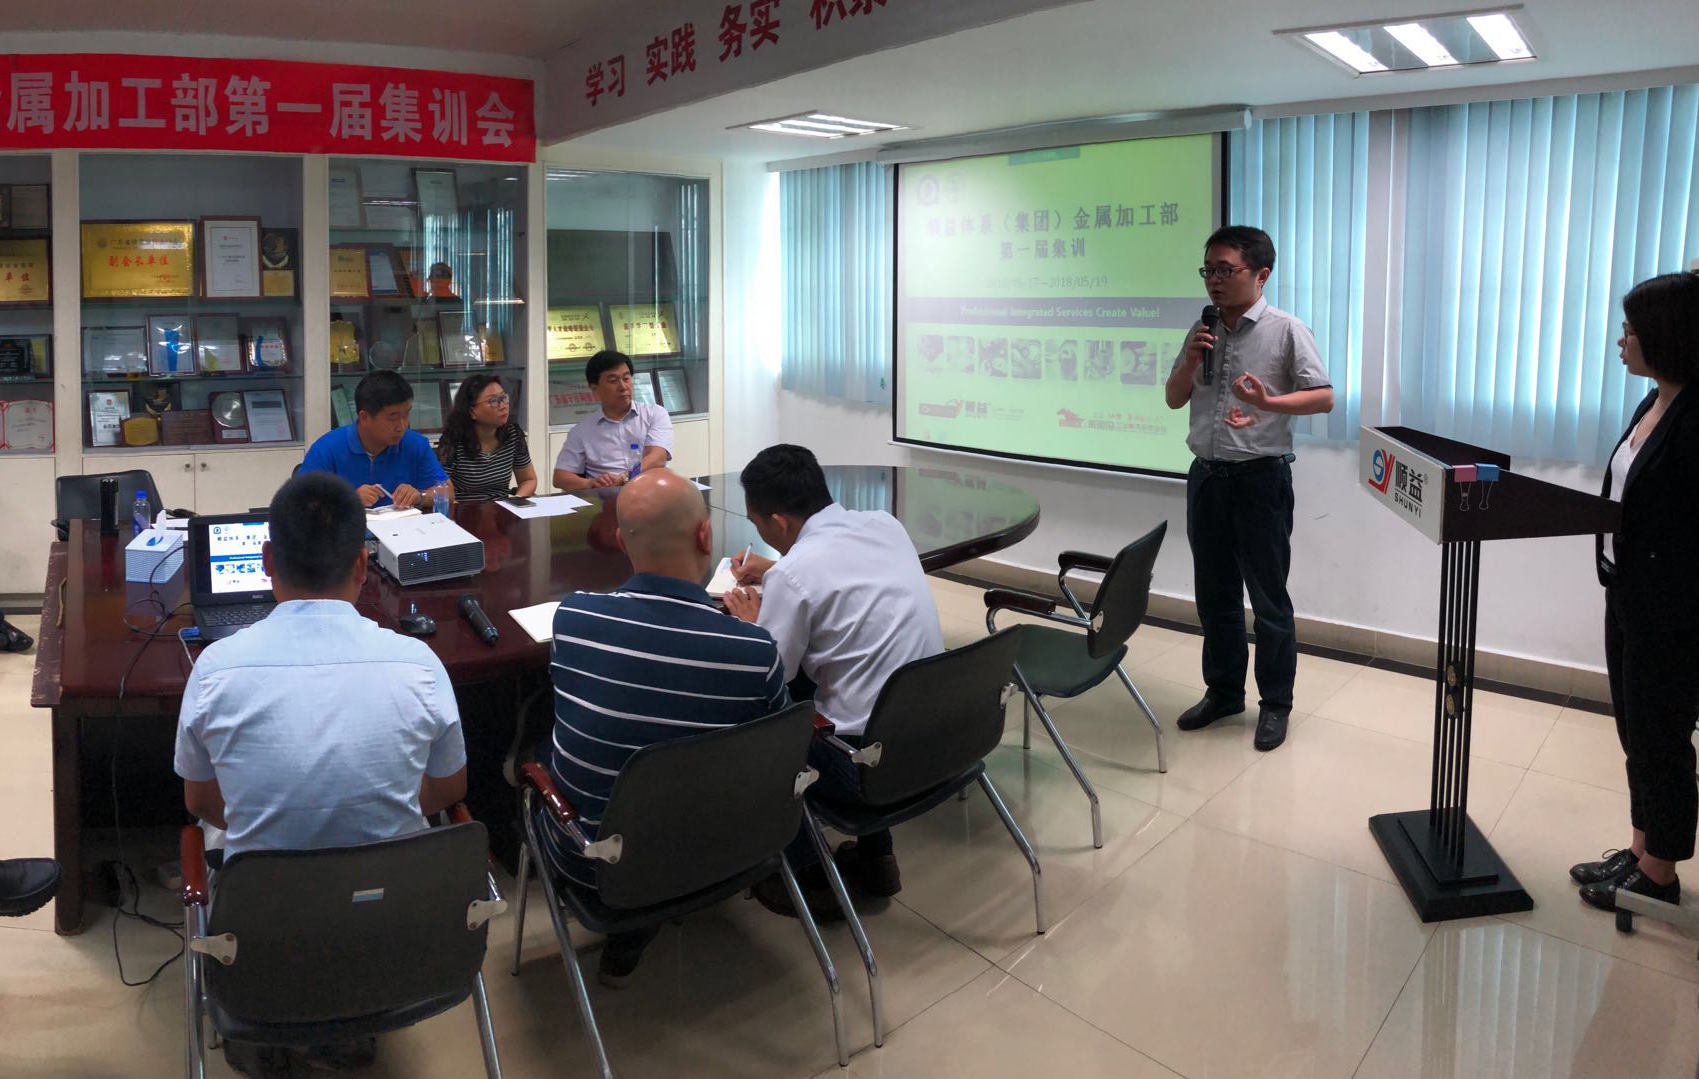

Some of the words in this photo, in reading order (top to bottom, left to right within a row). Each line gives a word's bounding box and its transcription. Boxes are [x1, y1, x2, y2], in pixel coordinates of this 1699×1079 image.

[585, 54, 625, 107] 学习
[645, 22, 696, 86] 实践
[718, 0, 781, 63] 务实
[1000, 237, 1087, 261] 第一届集训
[1056, 306, 1094, 318] Services
[1096, 306, 1127, 318] Create
[1129, 306, 1161, 318] Value!
[1394, 492, 1422, 519] SHUNYI
